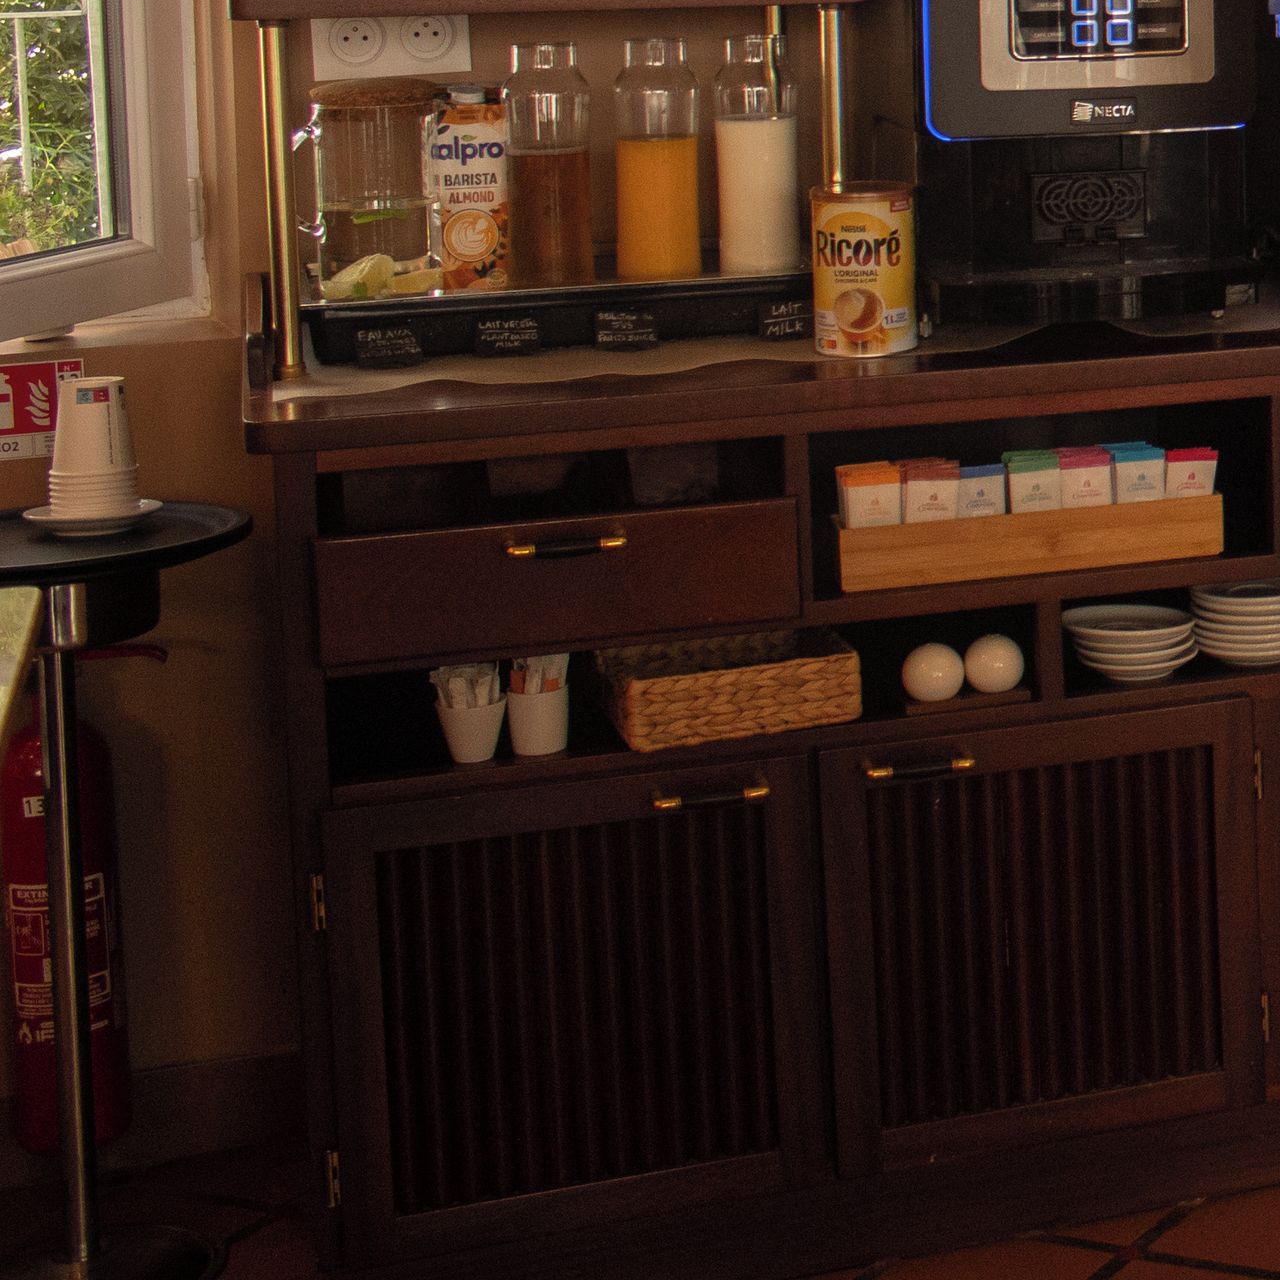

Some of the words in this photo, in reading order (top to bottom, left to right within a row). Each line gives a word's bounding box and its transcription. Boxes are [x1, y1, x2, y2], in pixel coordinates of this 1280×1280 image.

[1094, 105, 1135, 118] NECTA
[432, 135, 505, 166] alpro
[444, 172, 498, 187] BARISTA
[449, 190, 495, 204] ALMOND
[816, 229, 901, 267] Ricoré
[771, 302, 803, 316] LAIT
[766, 320, 804, 336] MILK
[0, 441, 20, 453] O2
